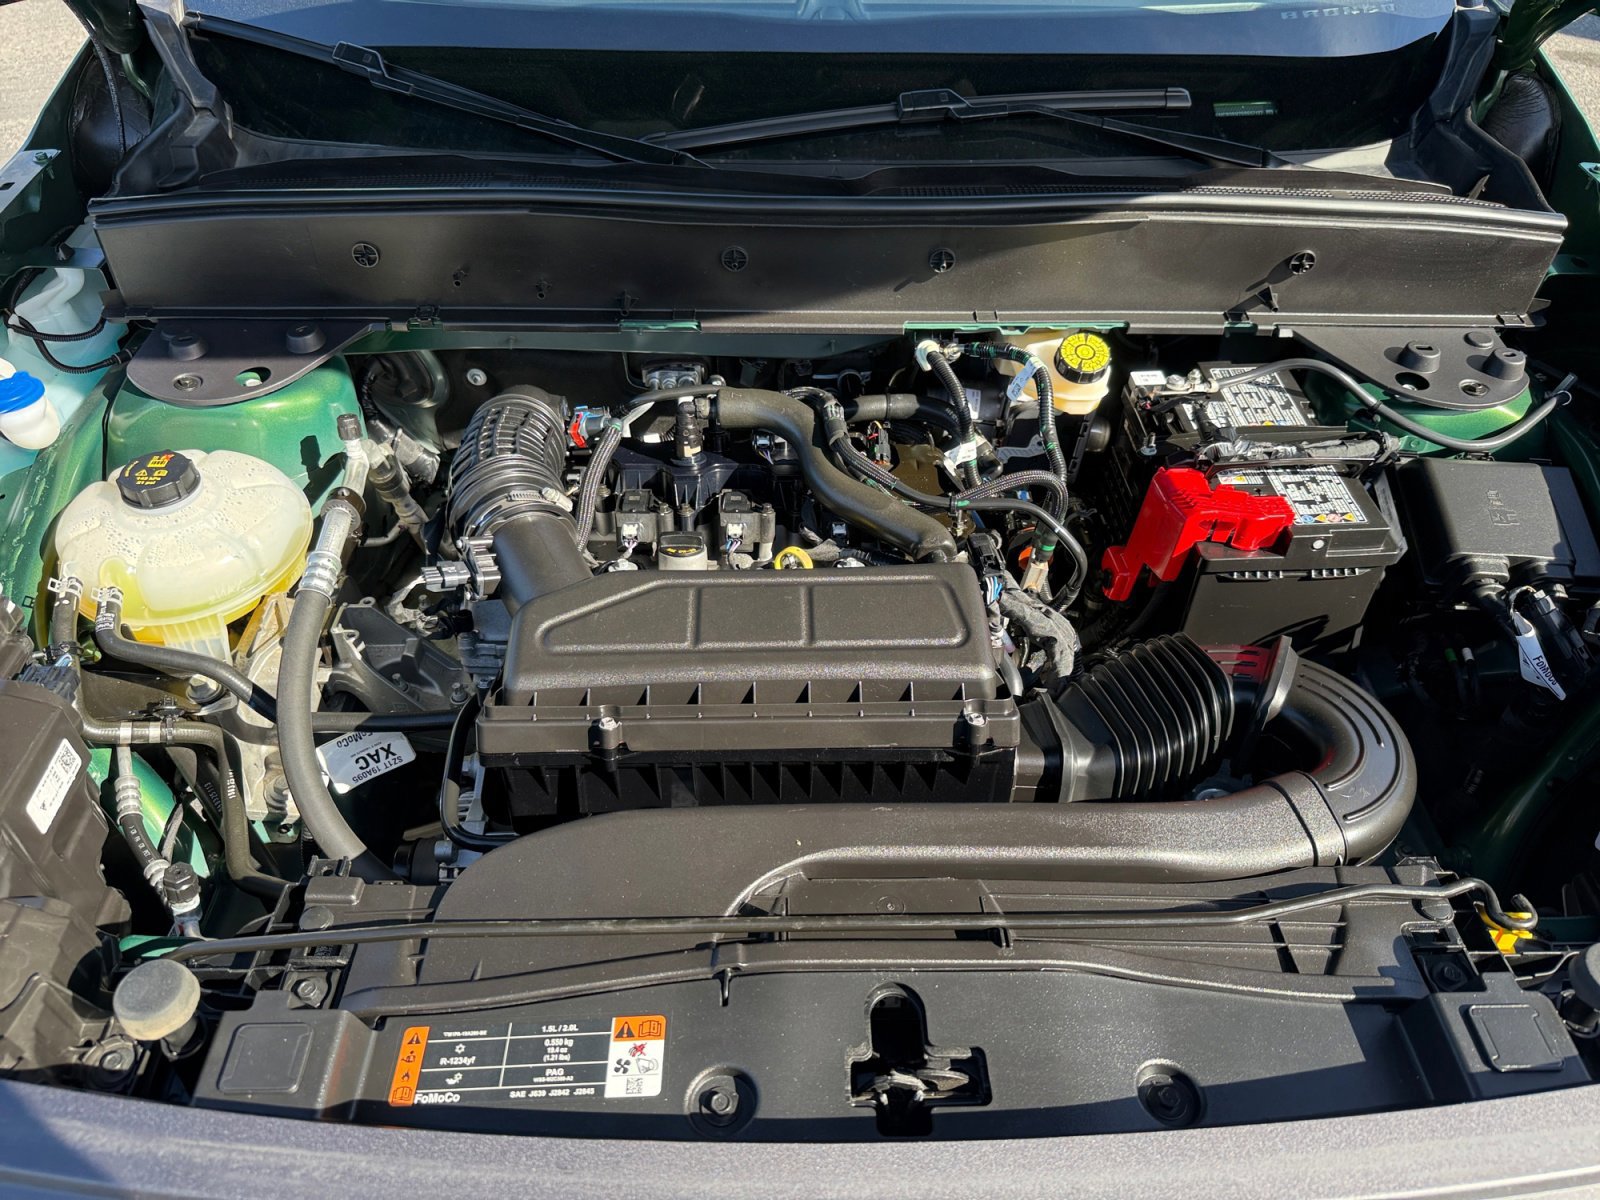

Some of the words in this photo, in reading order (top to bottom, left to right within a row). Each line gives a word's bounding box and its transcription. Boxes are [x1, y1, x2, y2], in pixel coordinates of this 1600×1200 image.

[355, 743, 397, 770] XAC
[352, 766, 381, 783] 19A095
[541, 1025, 557, 1033] 1.5L
[544, 1038, 563, 1046] 0.550
[564, 1037, 573, 1047] kg
[440, 1055, 476, 1066] R-1234yf
[545, 1068, 565, 1076] PAG
[413, 1092, 461, 1104] FoMoCo
[509, 1090, 526, 1098] SAE
[548, 1088, 571, 1097] J2842
